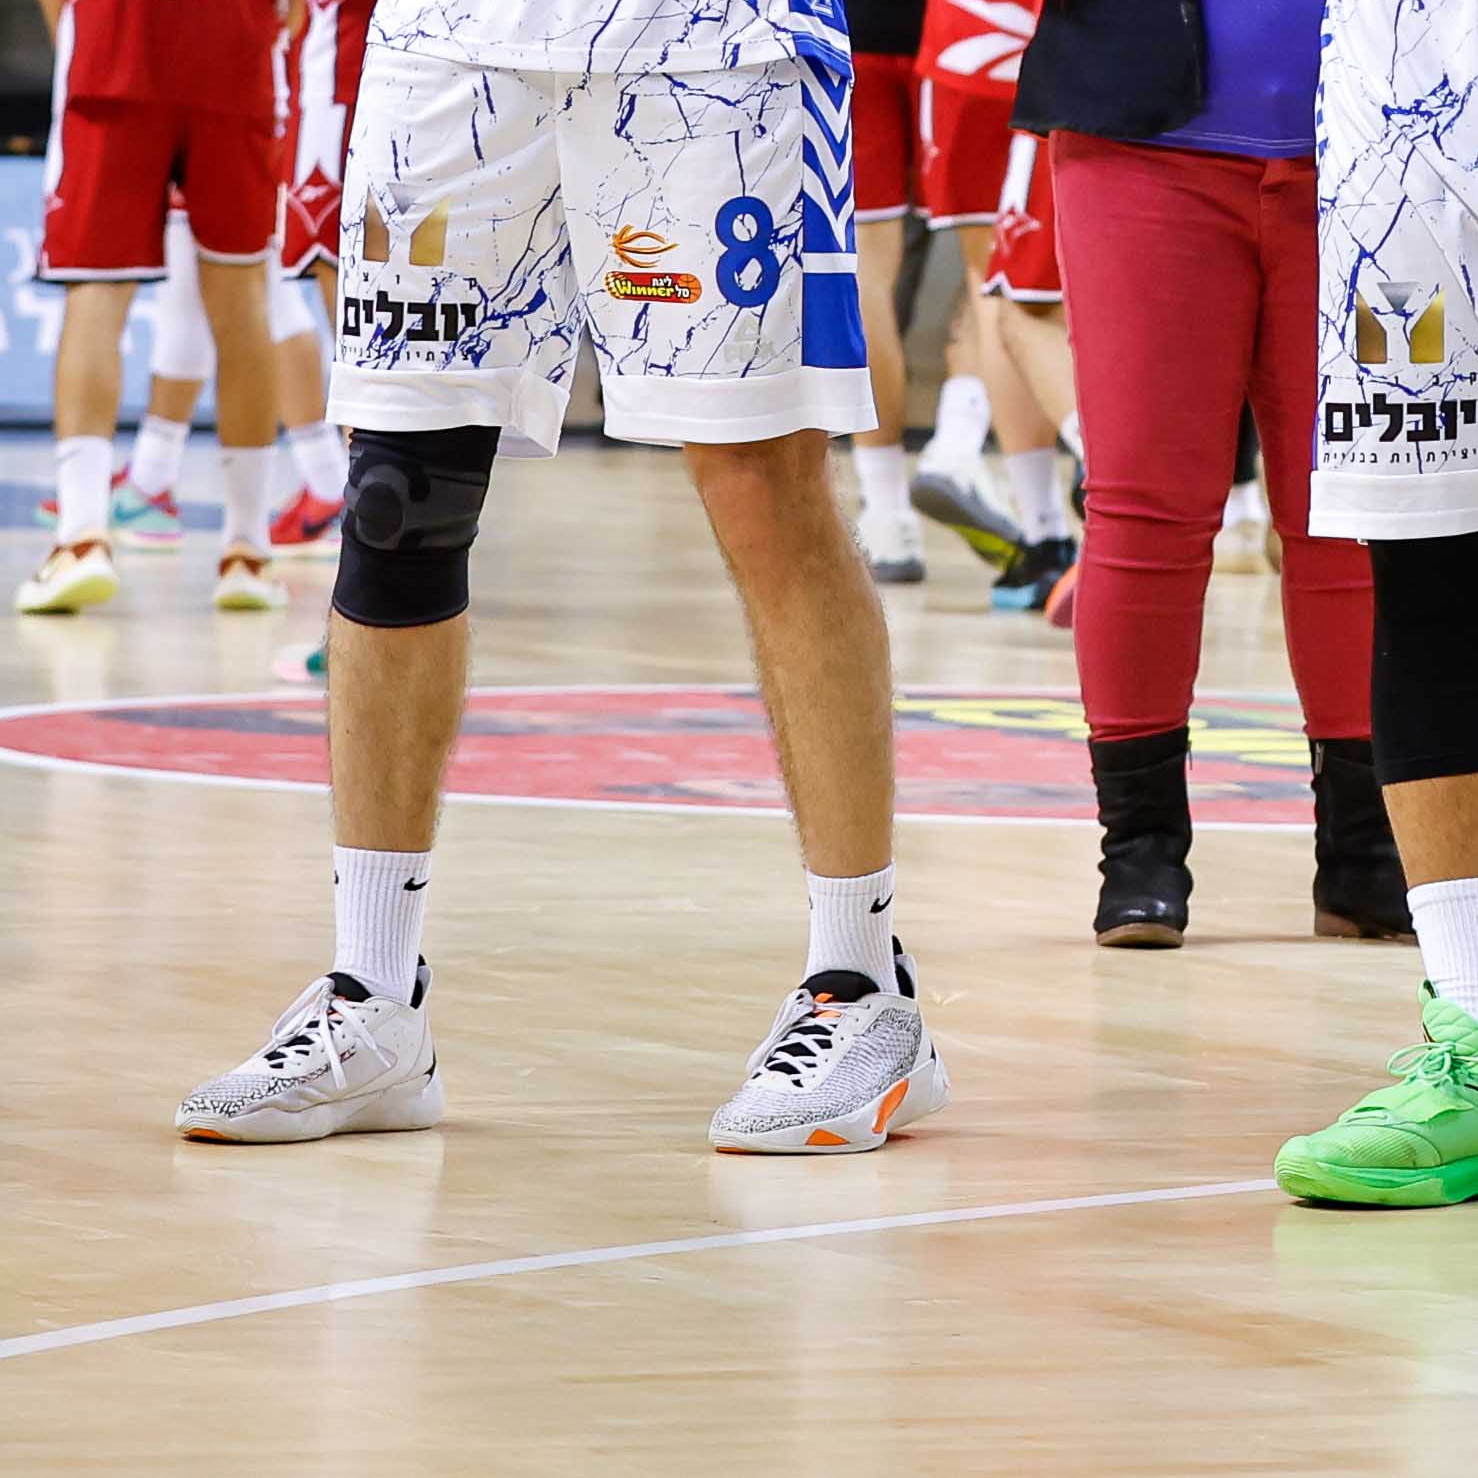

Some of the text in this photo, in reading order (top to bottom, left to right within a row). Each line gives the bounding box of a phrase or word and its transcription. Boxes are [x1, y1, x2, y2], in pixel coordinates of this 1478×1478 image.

[715, 196, 780, 307] 8
[363, 273, 477, 290] קבוצ
[615, 279, 675, 298] Winner
[674, 286, 690, 299] סל
[343, 290, 477, 342] יובלים
[1325, 393, 1477, 442] יובלים
[1390, 448, 1477, 463] יצירתות
